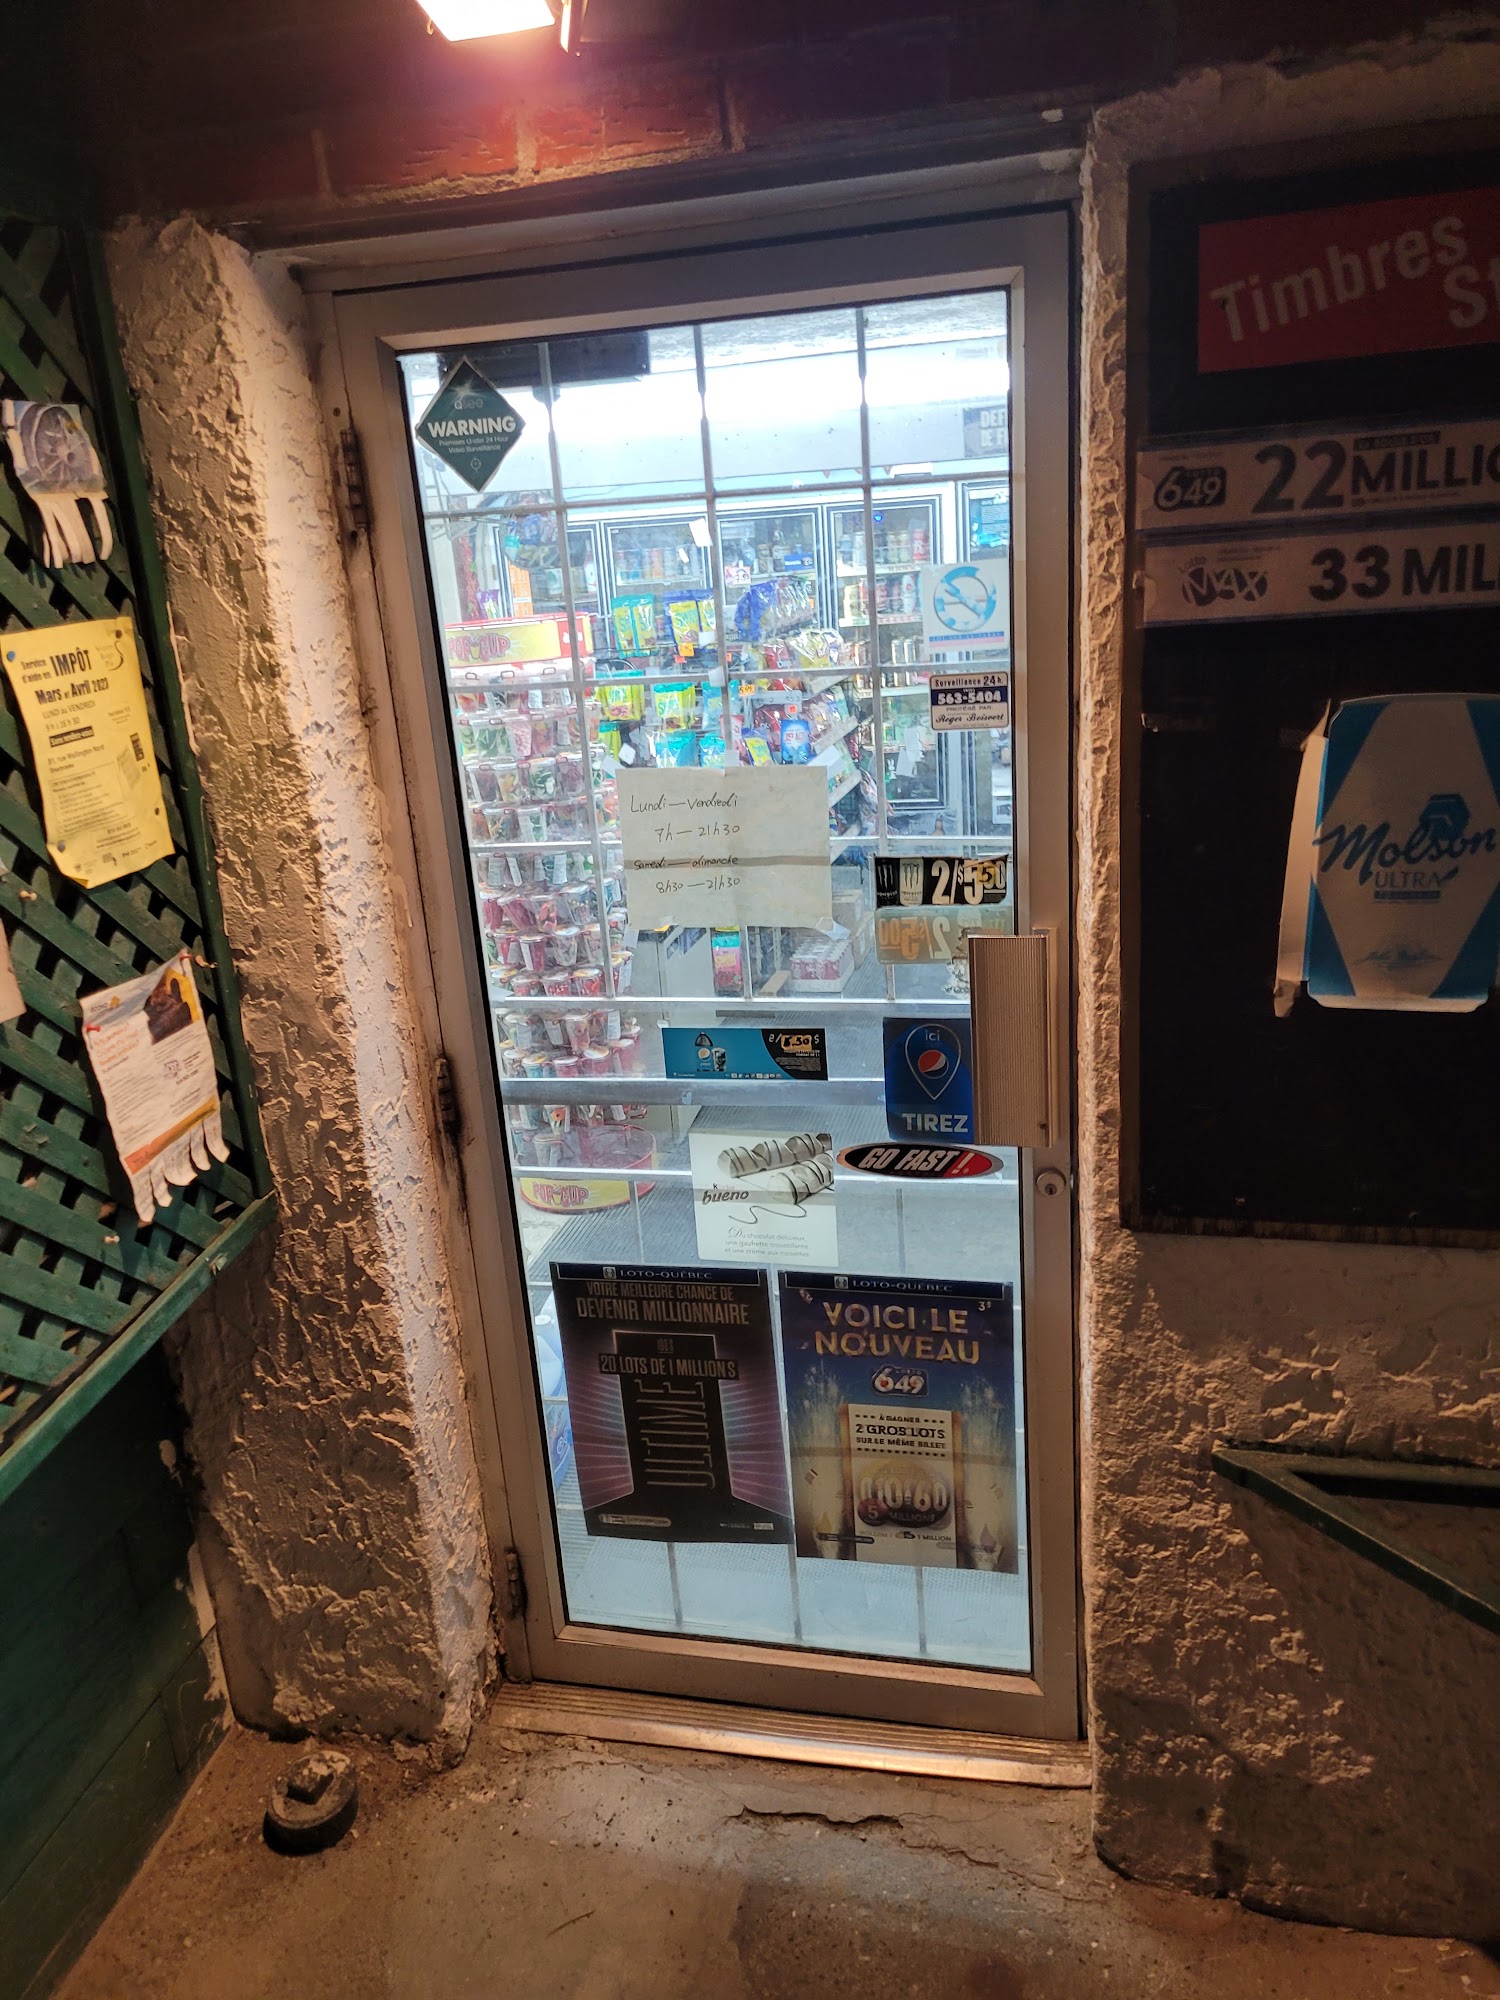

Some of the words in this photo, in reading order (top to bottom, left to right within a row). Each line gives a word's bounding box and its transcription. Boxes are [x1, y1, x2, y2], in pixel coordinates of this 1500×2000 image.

[1211, 215, 1468, 344] Timbres
[427, 415, 517, 438] WARNING
[448, 446, 465, 454] Video
[466, 444, 501, 453] Surveillance
[1252, 439, 1348, 514] 22
[1309, 545, 1393, 601] 33
[1403, 543, 1500, 596] MIL
[49, 646, 92, 677] IMPÔT
[935, 677, 981, 688] Surveillance
[983, 675, 996, 686] 24
[35, 688, 62, 705] Mars
[70, 679, 91, 698] Avril
[937, 689, 1002, 705] 563-5404
[655, 823, 673, 843] 7h
[1313, 821, 1497, 887] Molson
[1374, 871, 1442, 888] ULTRA
[925, 1029, 941, 1042] ici
[902, 1112, 969, 1133] TIREZ
[858, 1147, 894, 1170] GO
[702, 1189, 750, 1206] bueno
[747, 1232, 775, 1240] chocolat
[620, 1268, 712, 1280] LOTO-QUÉBEC
[587, 1281, 618, 1297] VOTRE
[620, 1283, 674, 1299] MEILLEURE
[676, 1285, 718, 1300] CHANCE
[720, 1286, 734, 1301] DE
[852, 1279, 953, 1292] LOTO-QUÉBEC
[576, 1297, 640, 1321] DEVENIR
[642, 1300, 750, 1325] MILLIONNAIRE
[822, 1301, 916, 1330] VOICI
[930, 1307, 969, 1334] LE
[814, 1330, 980, 1366] NOUVEAU
[600, 1355, 617, 1372] 20
[619, 1356, 648, 1375] LOTS
[650, 1357, 667, 1375] DE
[886, 1415, 921, 1424] GAGNER
[855, 1423, 864, 1434] 2
[866, 1424, 907, 1437] GROS
[910, 1427, 946, 1440] LOTS
[855, 1436, 873, 1444] SUR
[887, 1437, 915, 1447] MÊME
[917, 1440, 947, 1450] BILLET
